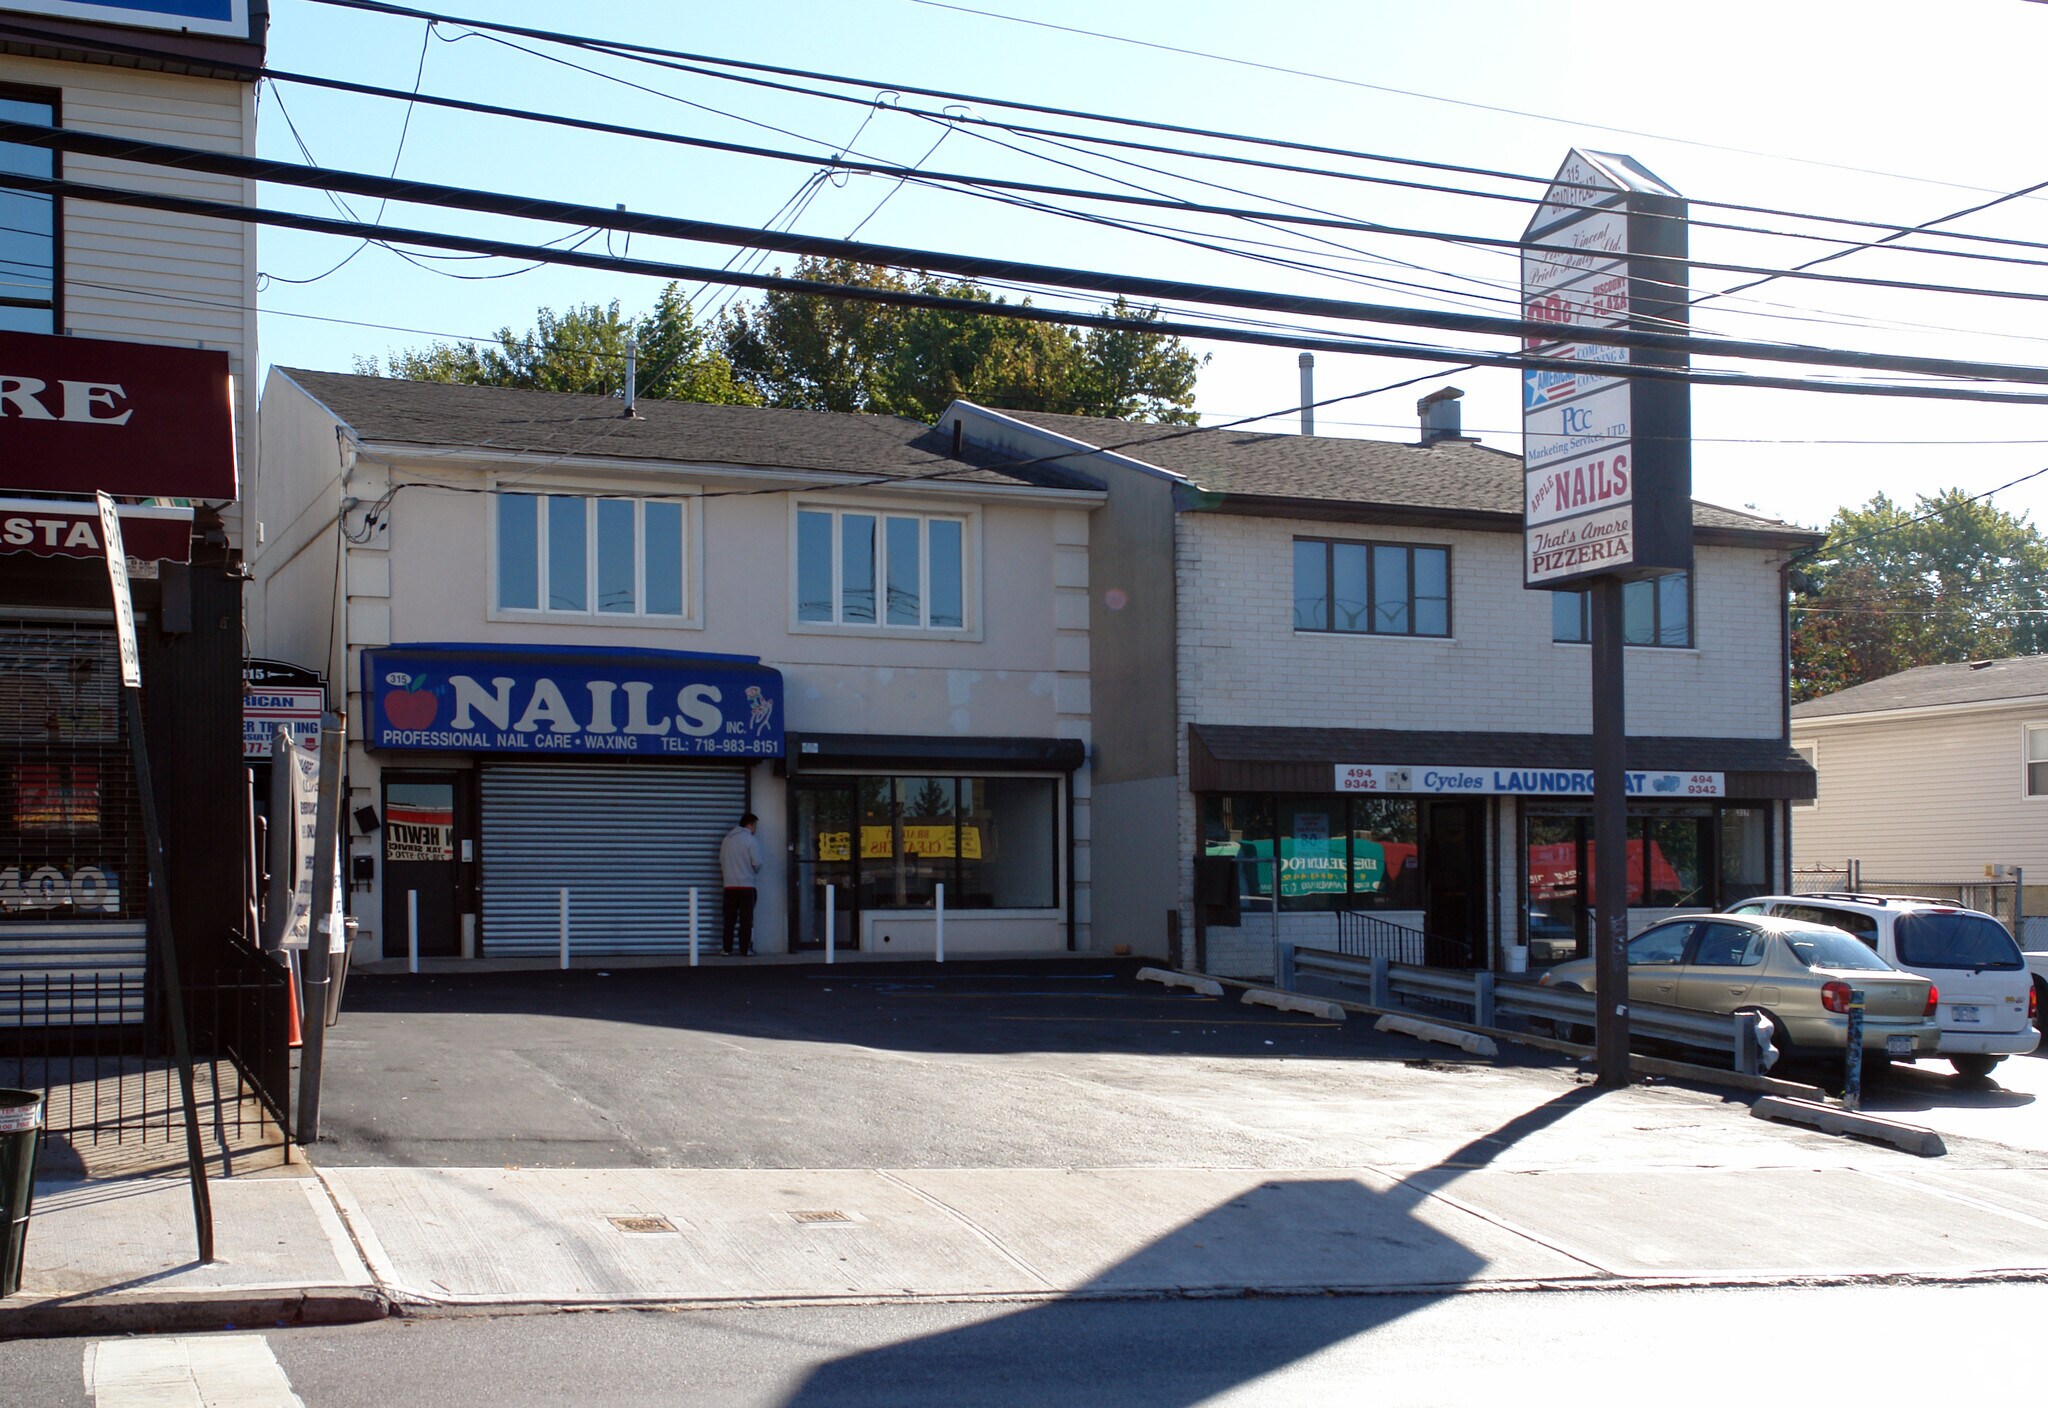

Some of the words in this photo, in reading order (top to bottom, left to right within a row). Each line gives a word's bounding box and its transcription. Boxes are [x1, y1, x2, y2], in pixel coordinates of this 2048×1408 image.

[1592, 290, 1628, 320] PLAZA
[1561, 406, 1592, 435] PCC
[1528, 439, 1568, 461] Marketing
[1607, 423, 1628, 438] LTD.
[1531, 475, 1554, 513] APPLE
[1555, 455, 1628, 512] NAILS
[0, 517, 100, 549] STA
[1532, 529, 1576, 554] That's
[1581, 518, 1629, 541] Amore
[1533, 537, 1629, 574] PIZZERIA
[390, 674, 408, 684] 315
[448, 675, 723, 737] NAILS
[726, 721, 747, 734] INC.
[383, 730, 491, 747] PROFESSIONAL
[497, 733, 529, 748] NAIL
[535, 734, 572, 749] CARE
[584, 735, 638, 751] WAXING
[661, 737, 689, 751] TEL:
[695, 738, 779, 753] 718-983-8151
[1344, 779, 1377, 789] 9342
[1688, 785, 1717, 794] 9342
[1347, 769, 1372, 778] 494
[1424, 771, 1483, 791] Cycles
[1494, 771, 1647, 793] LAUNDROAT
[1691, 774, 1713, 784] 494
